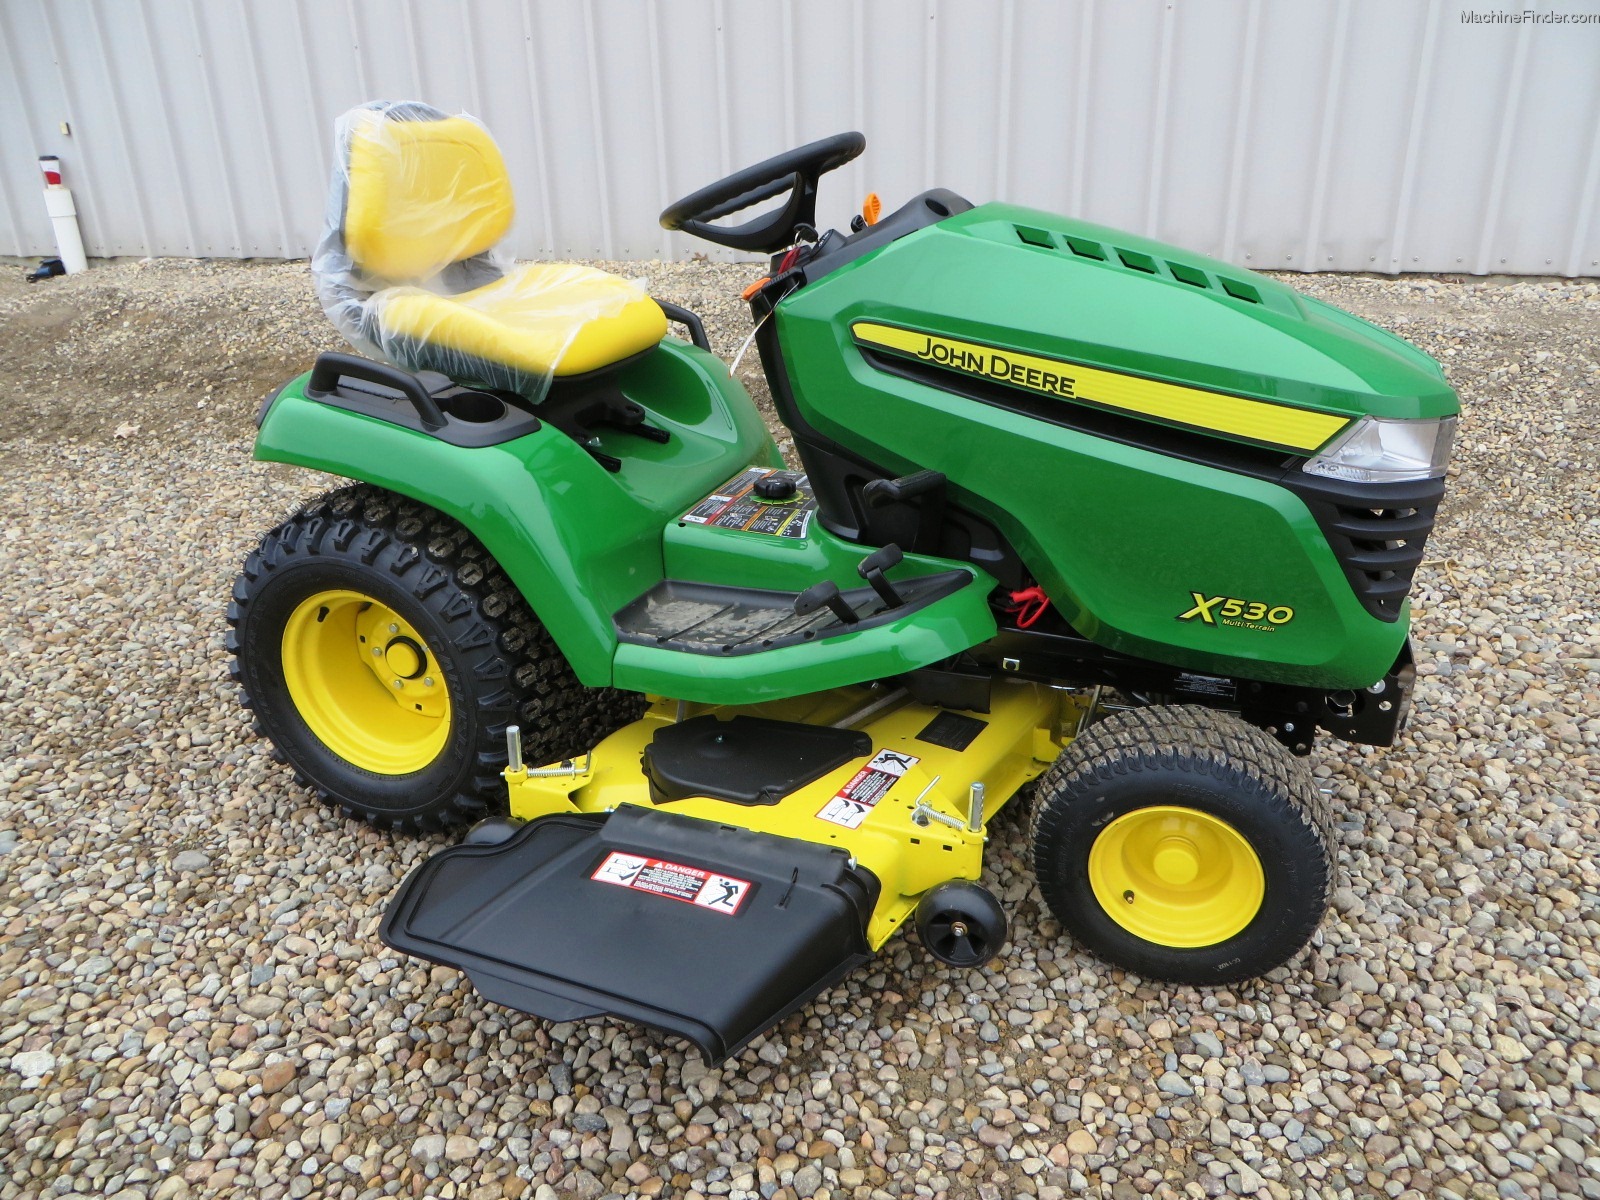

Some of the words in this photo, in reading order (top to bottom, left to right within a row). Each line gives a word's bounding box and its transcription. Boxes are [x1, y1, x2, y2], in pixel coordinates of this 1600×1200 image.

[917, 338, 984, 373] JOHN
[990, 355, 1076, 396] DEERE
[1176, 591, 1295, 627] X530
[845, 770, 868, 789] DANGER
[664, 863, 705, 878] DANGER
